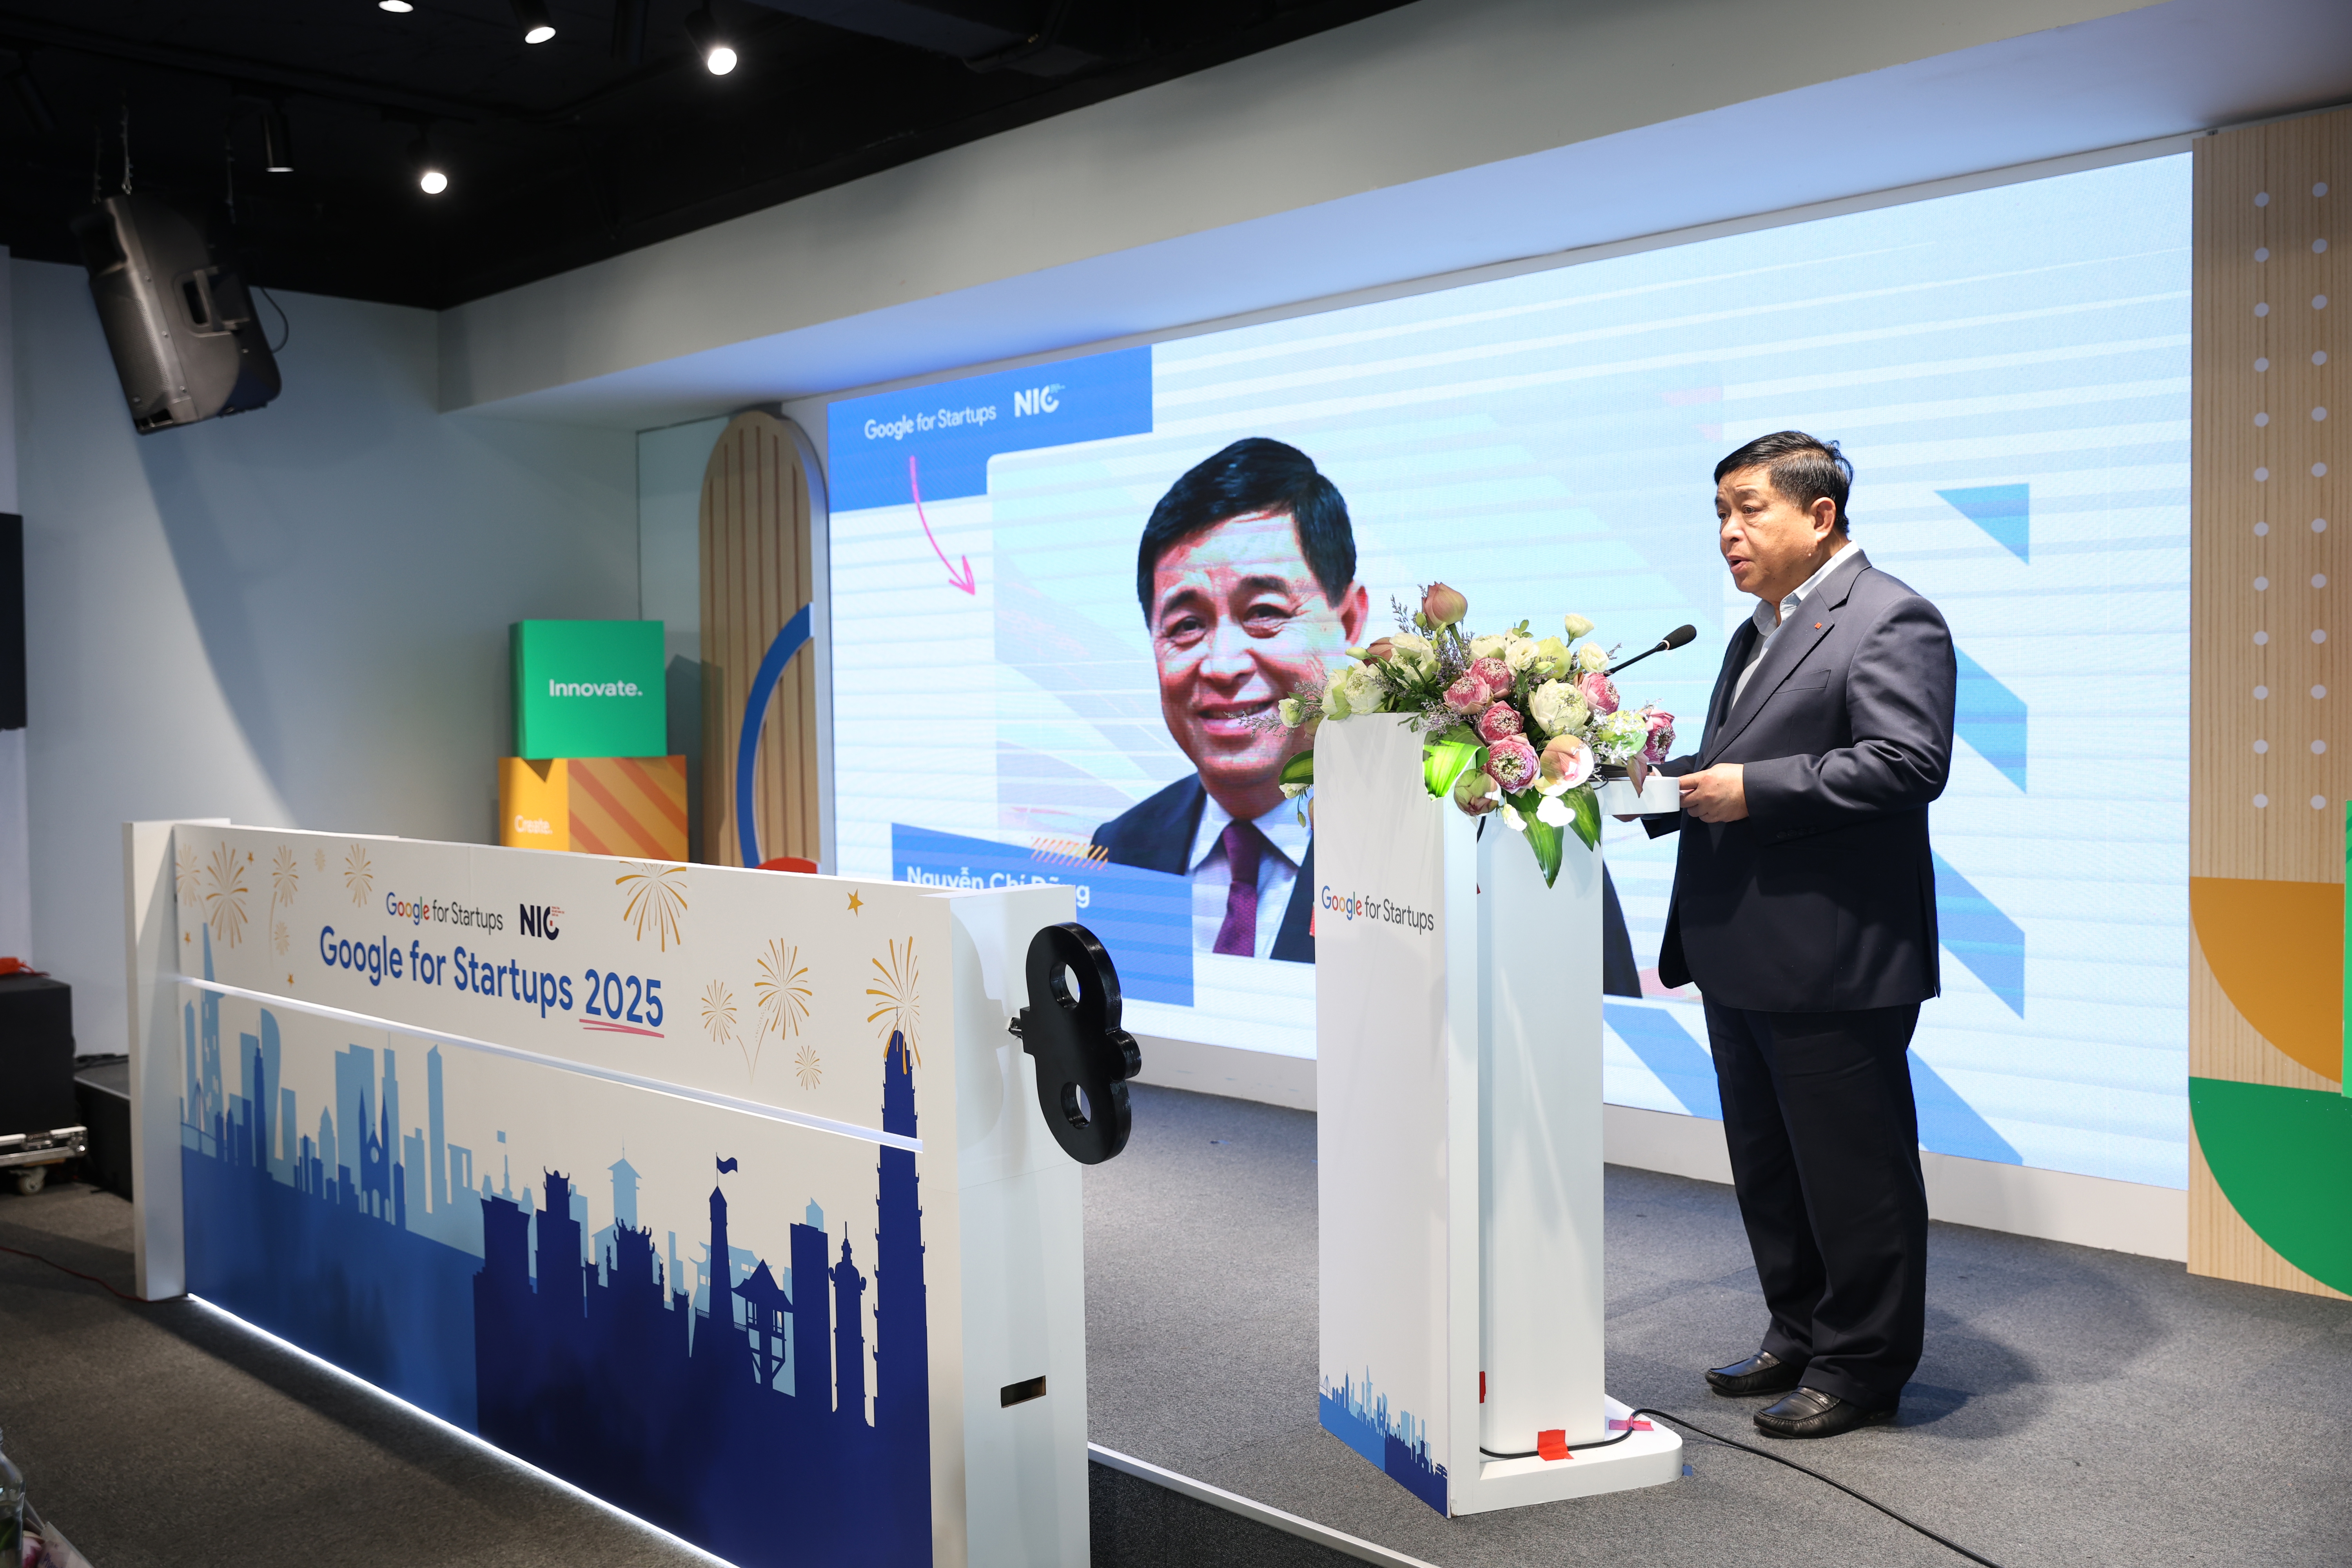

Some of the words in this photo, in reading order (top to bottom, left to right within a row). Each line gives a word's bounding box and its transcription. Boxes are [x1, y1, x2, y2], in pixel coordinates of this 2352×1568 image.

[1014, 385, 1059, 417] NIC
[864, 414, 914, 441] Google
[916, 412, 936, 432] for
[937, 405, 997, 428] Startups
[549, 679, 643, 697] Innovate.
[514, 815, 553, 835] Create.
[386, 892, 430, 925] Google
[432, 899, 449, 923] for
[451, 902, 503, 935] Startups
[520, 904, 559, 940] NIC
[1322, 886, 1362, 920] Google
[1365, 895, 1381, 919] for
[1383, 898, 1434, 935] Startups
[320, 926, 403, 986] Google
[410, 940, 446, 985] for
[454, 946, 573, 1019] Startups
[585, 969, 663, 1027] 2025
